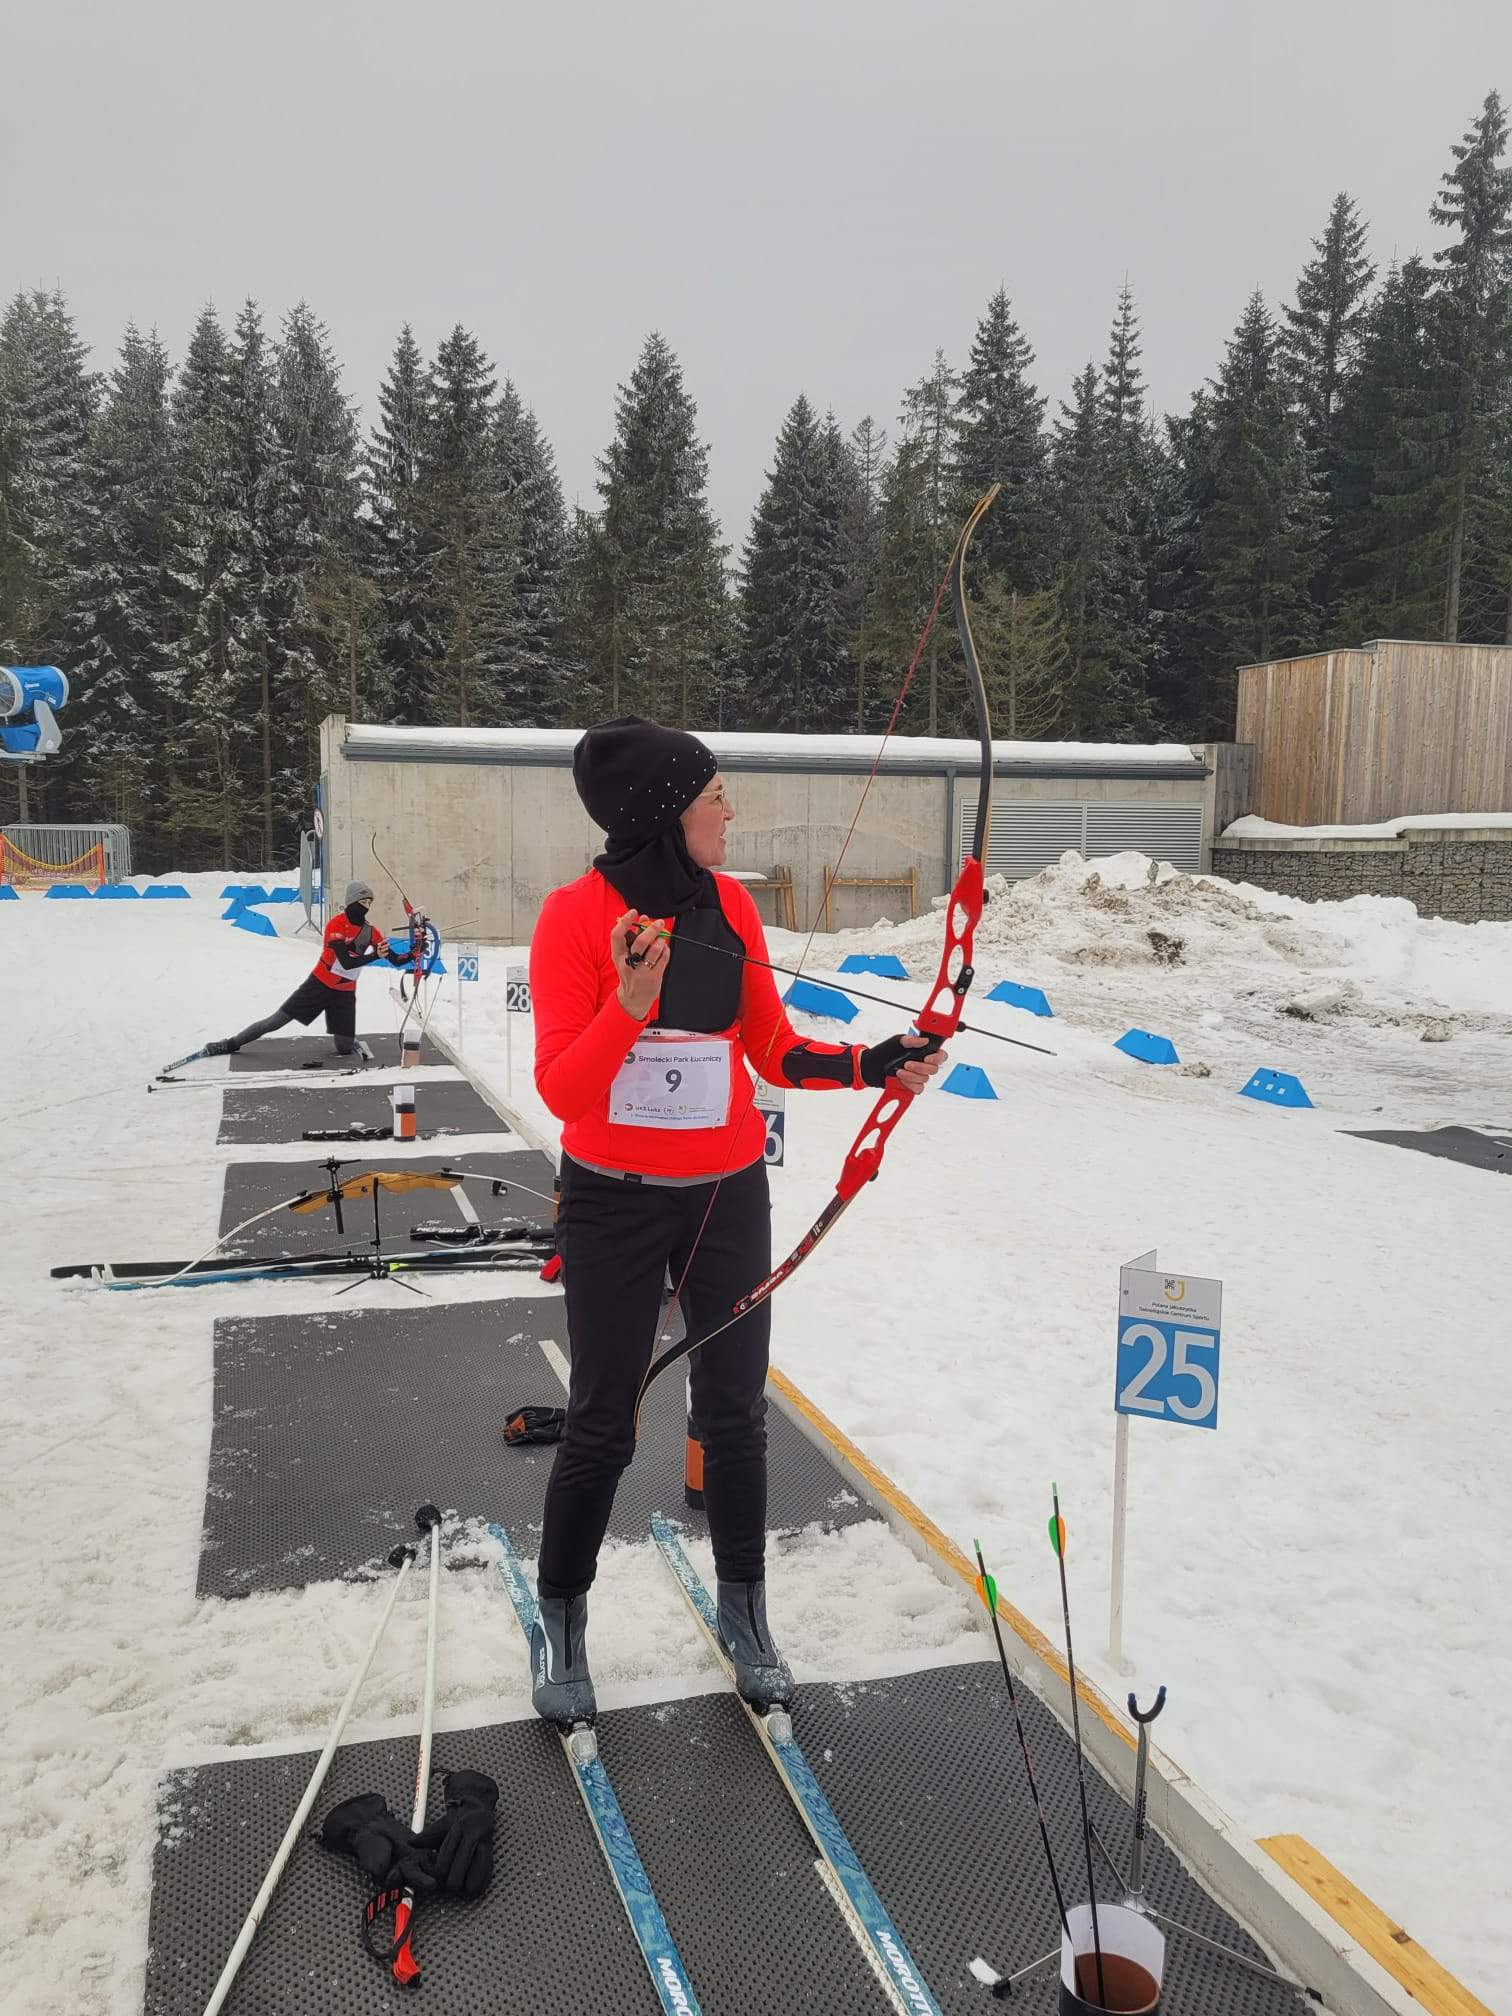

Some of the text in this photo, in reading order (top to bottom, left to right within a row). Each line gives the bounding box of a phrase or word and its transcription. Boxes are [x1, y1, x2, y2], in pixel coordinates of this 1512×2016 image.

[458, 957, 478, 980] 29
[507, 983, 531, 1012] 28
[638, 1055, 672, 1063] Smolecki
[665, 1069, 682, 1093] 9
[1119, 1323, 1216, 1421] 25
